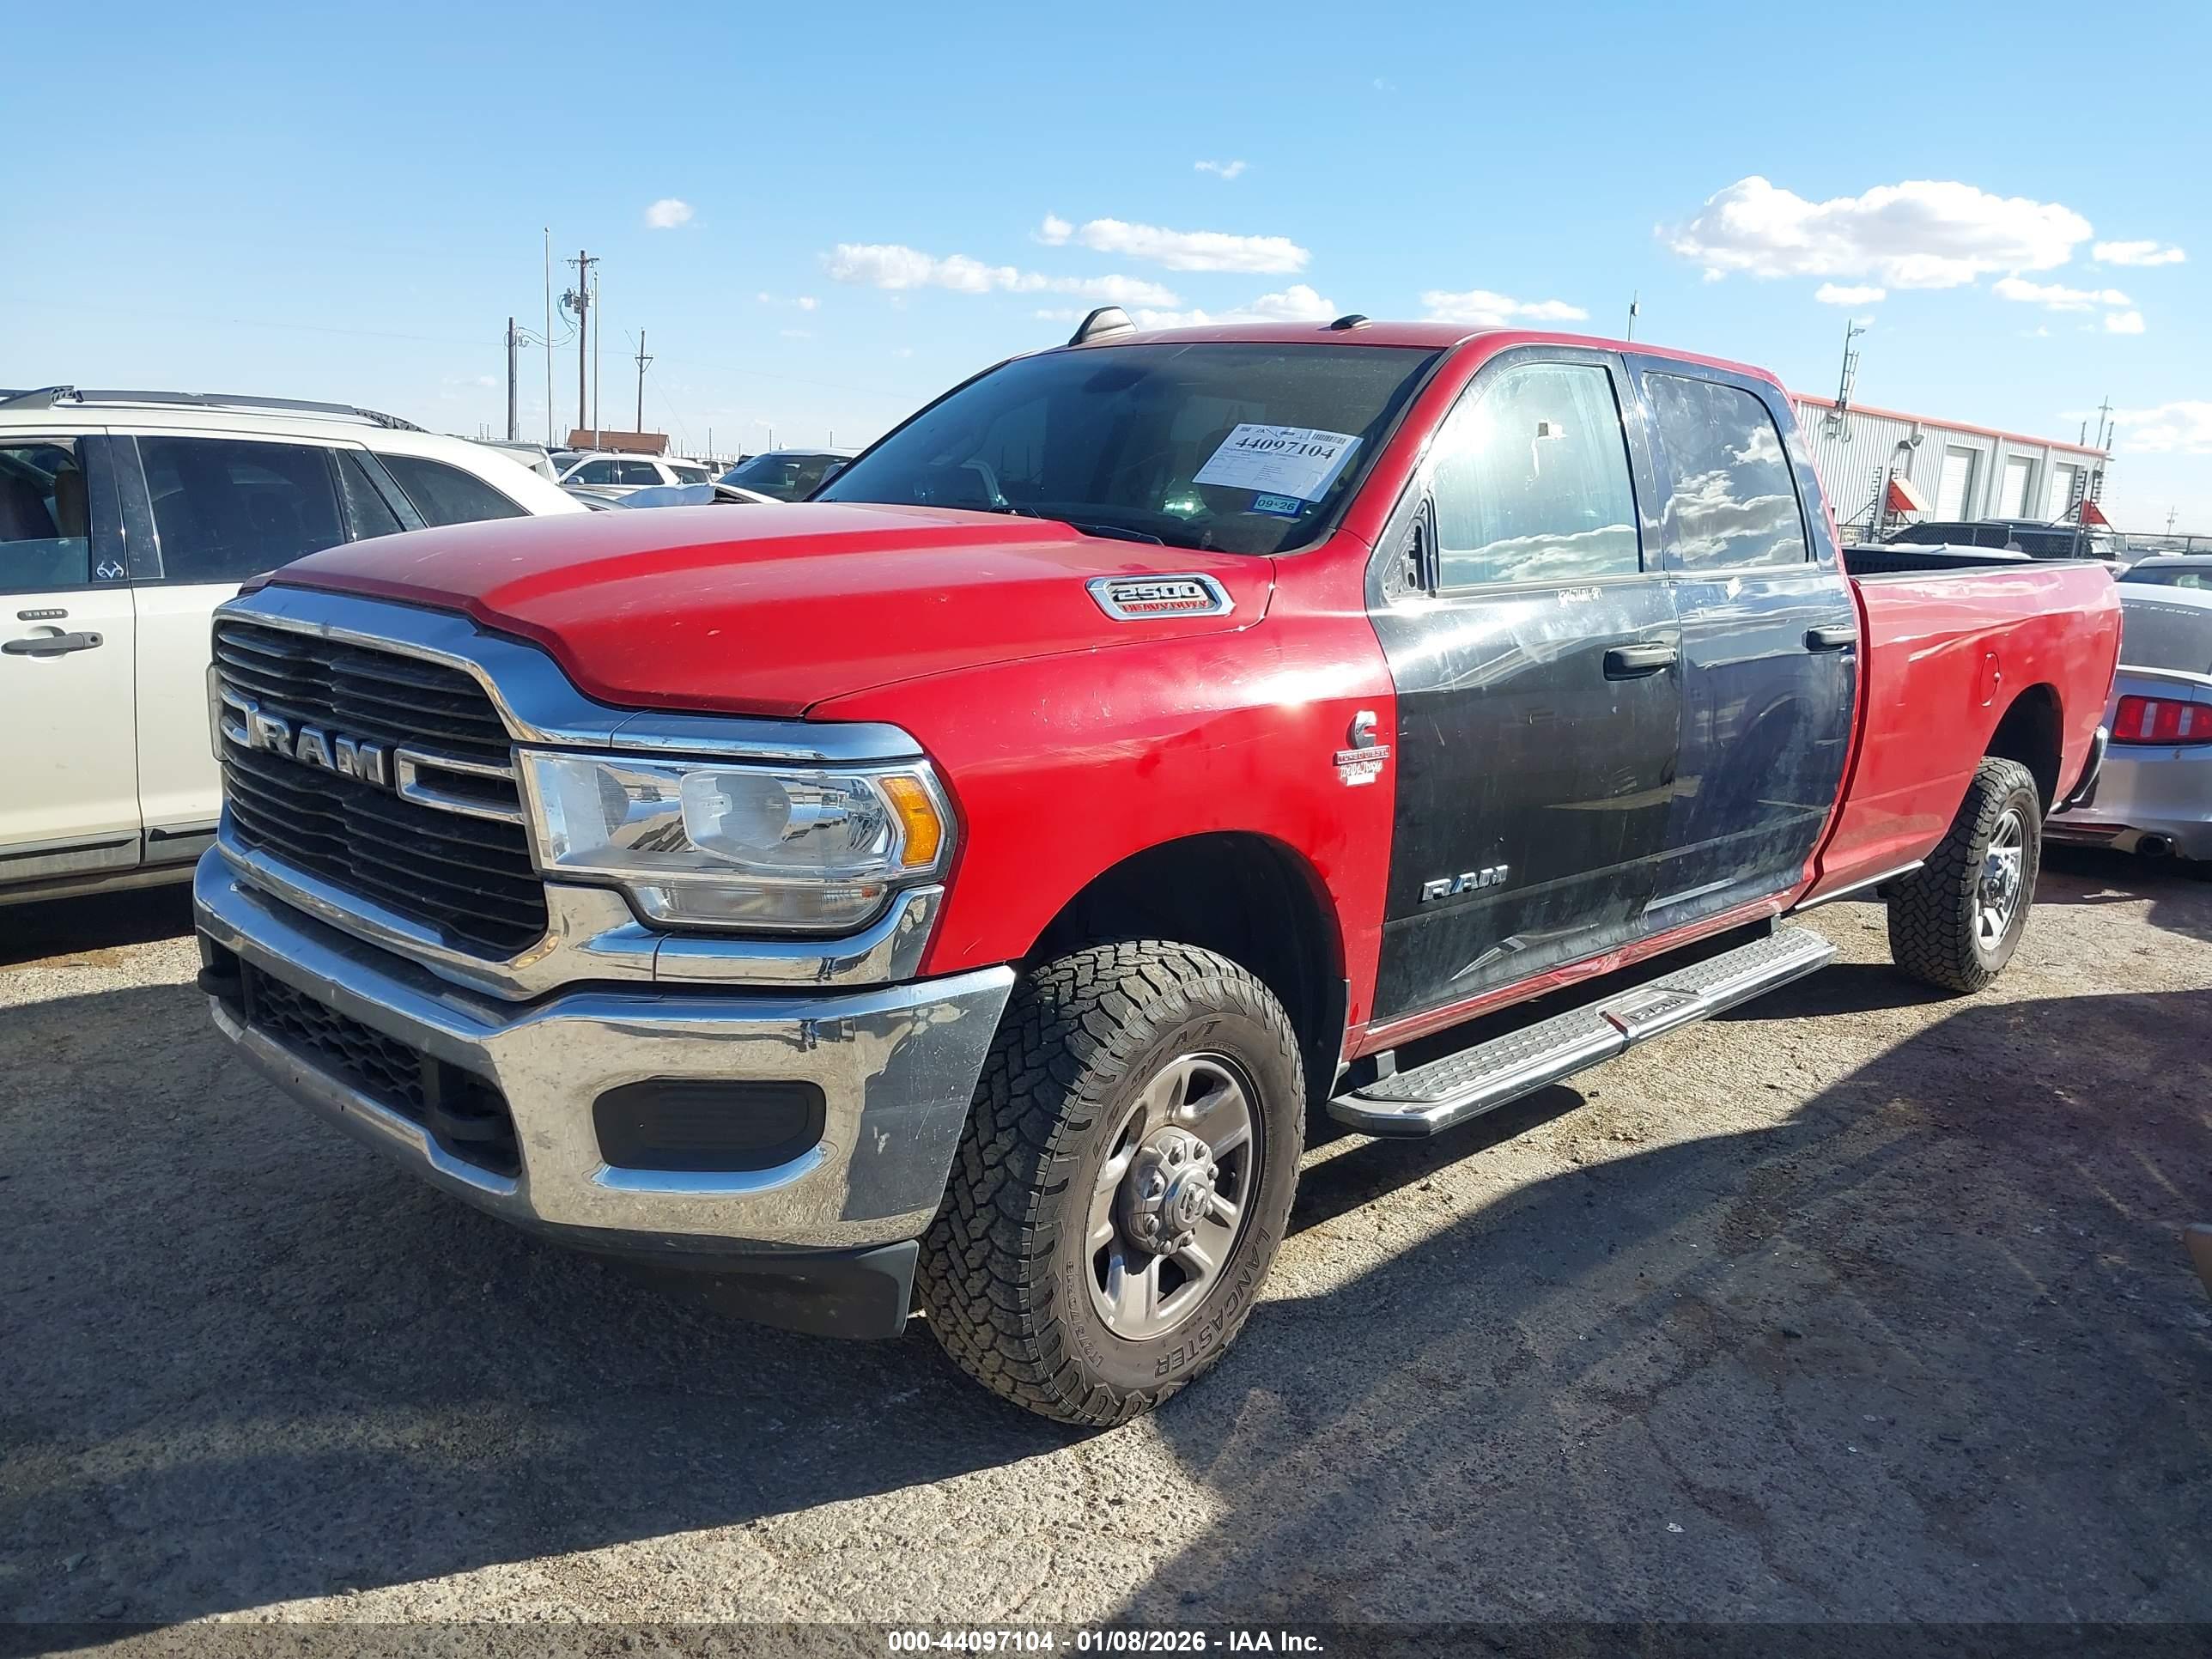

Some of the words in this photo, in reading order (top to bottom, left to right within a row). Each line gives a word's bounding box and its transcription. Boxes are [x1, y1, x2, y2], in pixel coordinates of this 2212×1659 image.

[1235, 437, 1335, 459] 44097104
[1257, 499, 1273, 508] 09
[1278, 501, 1295, 511] 26
[1112, 584, 1204, 602] 2500
[256, 712, 385, 786] RAM
[1420, 865, 1509, 902] RAM
[1155, 1227, 1271, 1378] LANCASTER
